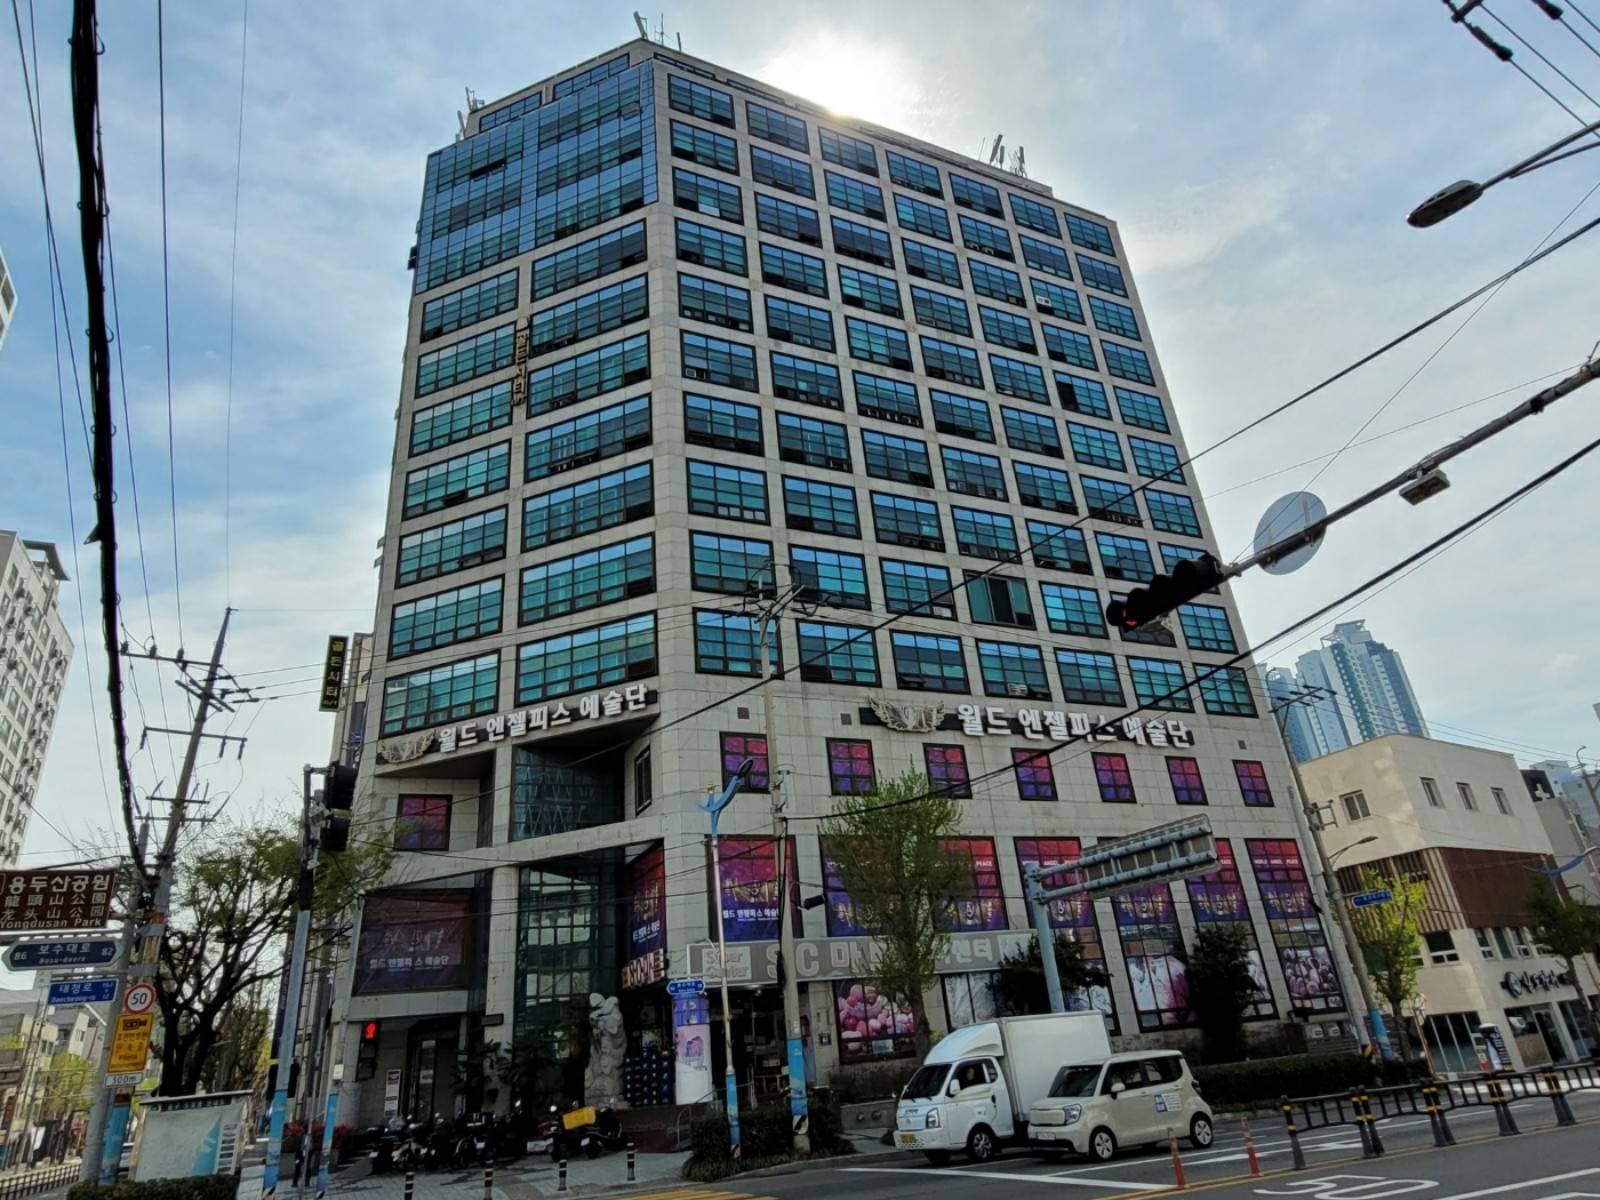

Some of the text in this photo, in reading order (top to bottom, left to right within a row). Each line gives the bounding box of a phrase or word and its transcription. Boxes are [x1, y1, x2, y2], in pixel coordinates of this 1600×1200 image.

[438, 683, 648, 753] 월드 엔젤피스 예술단
[957, 703, 1194, 748] 월드 엔젤피스 예술단
[8, 874, 110, 894] 용두산공원
[0, 917, 101, 929] Yongdusan Park
[37, 943, 91, 955] 보수대로
[101, 947, 114, 956] 82
[14, 951, 27, 961] 86
[131, 992, 148, 1006] 50
